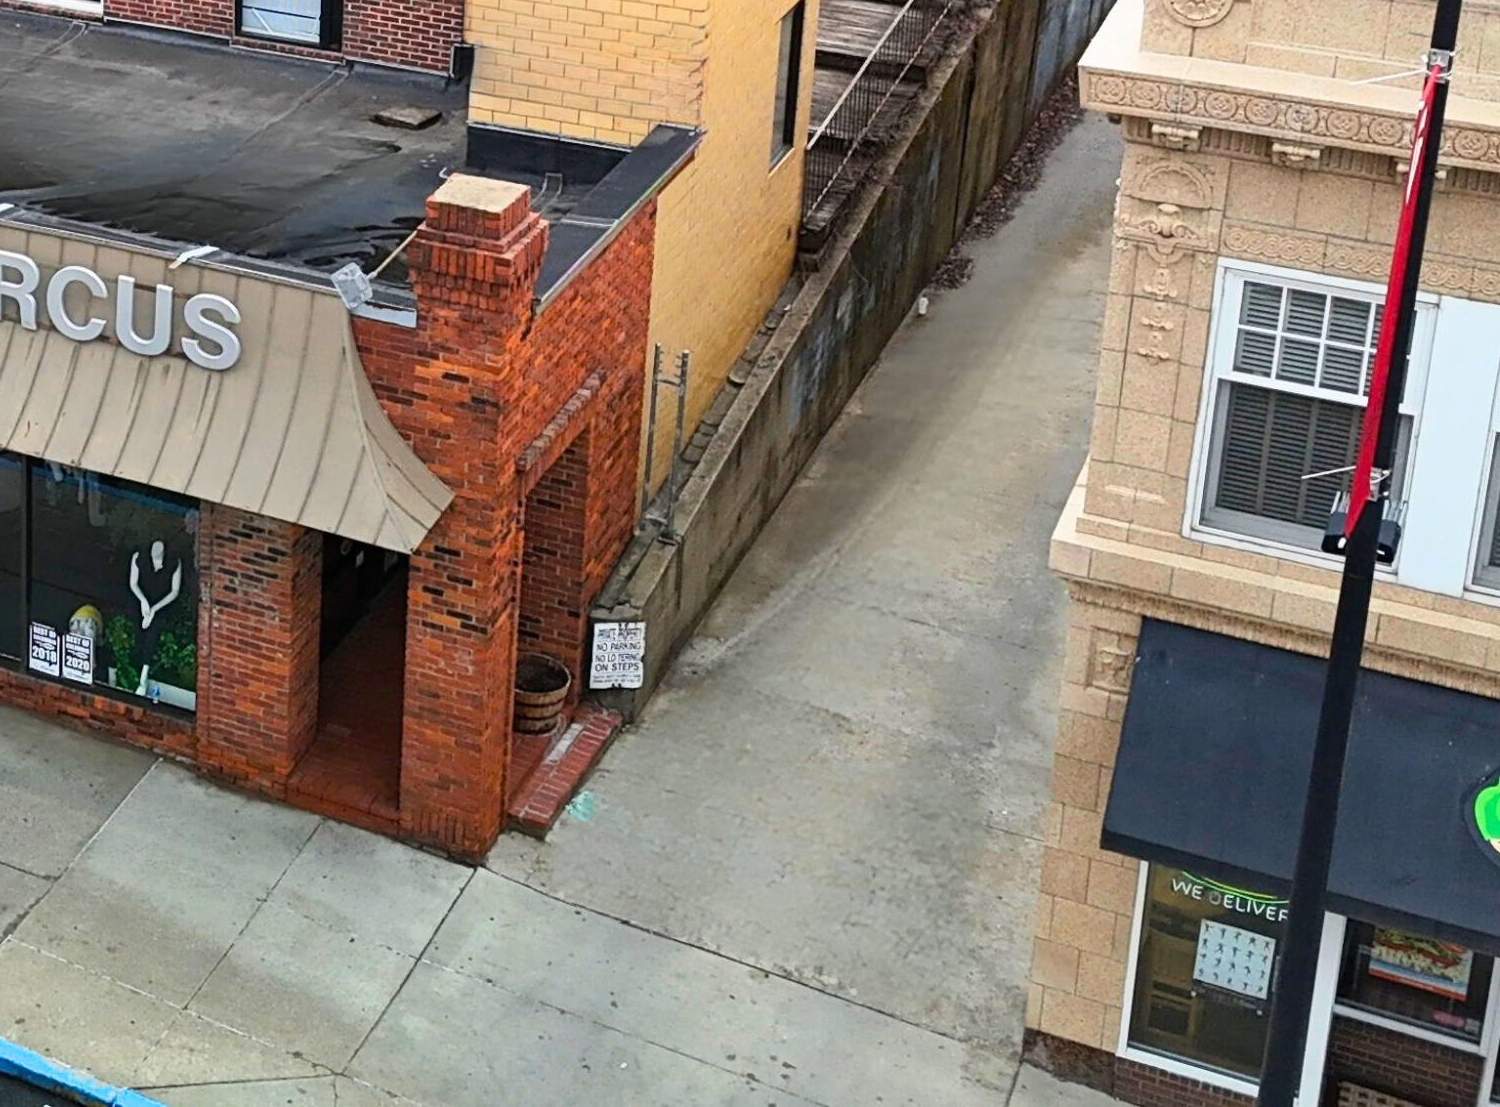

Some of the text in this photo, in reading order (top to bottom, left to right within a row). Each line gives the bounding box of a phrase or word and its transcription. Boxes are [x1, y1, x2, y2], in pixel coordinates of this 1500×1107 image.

[32, 645, 57, 663] 2018
[66, 655, 90, 671] 2020
[595, 662, 639, 672] ON STEPS
[1172, 878, 1204, 900] WE
